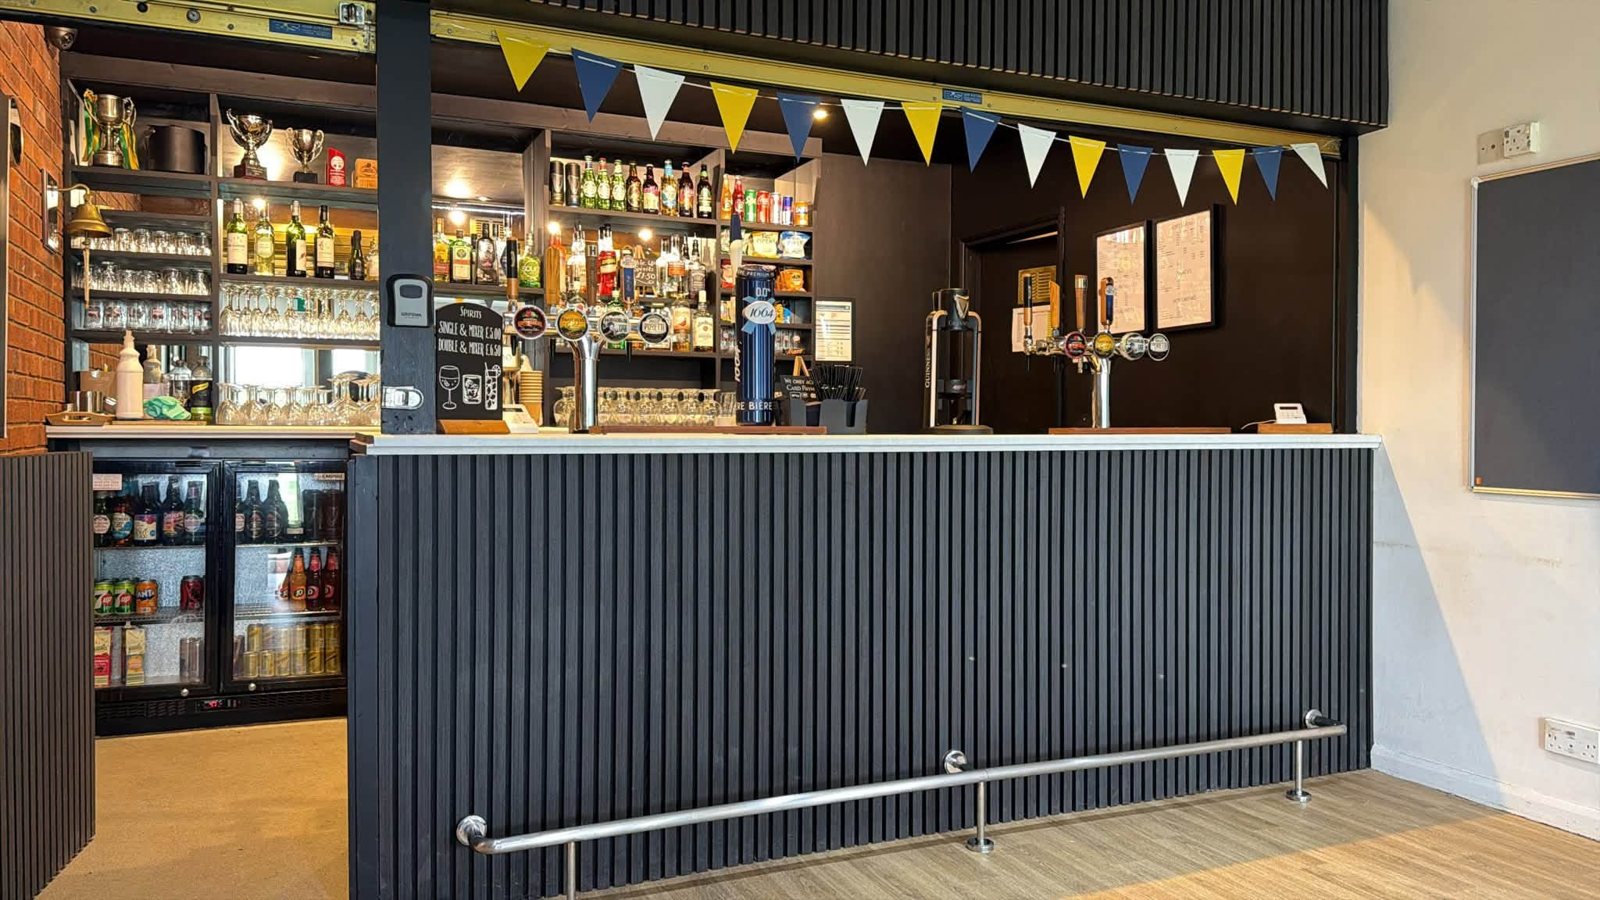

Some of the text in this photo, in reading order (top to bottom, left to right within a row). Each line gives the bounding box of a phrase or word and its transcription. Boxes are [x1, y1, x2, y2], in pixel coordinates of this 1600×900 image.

[749, 307, 774, 318] 1664
[438, 320, 459, 335] SINGLE
[459, 323, 468, 337] &
[468, 324, 484, 341] MIXER
[438, 338, 459, 353] DOUBLE
[459, 341, 468, 354] &
[468, 342, 484, 357] MIXER
